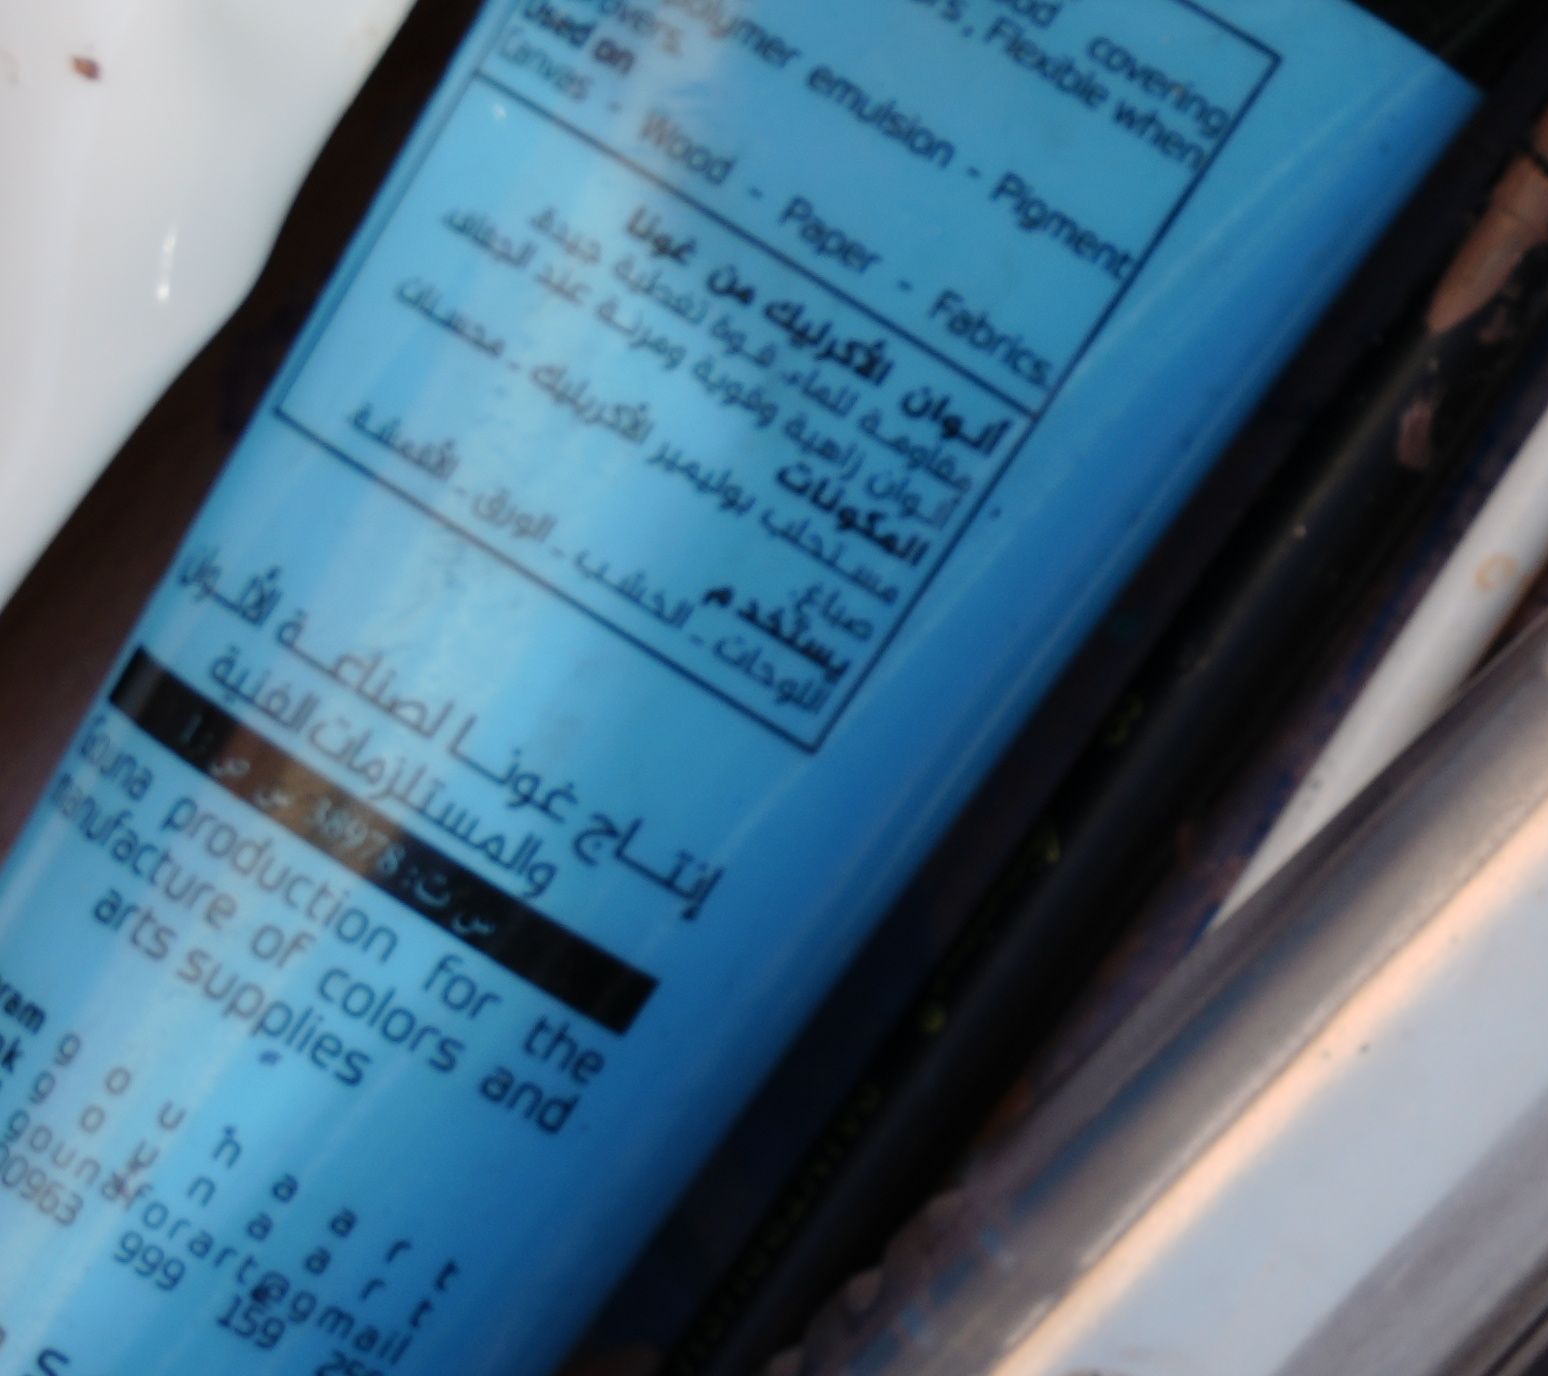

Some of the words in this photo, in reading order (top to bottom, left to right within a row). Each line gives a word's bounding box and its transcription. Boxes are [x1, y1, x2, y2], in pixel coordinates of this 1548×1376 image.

[592, 37, 635, 75] on
[983, 16, 1110, 110] Flexible
[1111, 100, 1209, 177] when
[1086, 36, 1233, 148] covering
[641, 113, 738, 188] Wood
[778, 196, 882, 274] Paper
[804, 65, 956, 169] emulsion
[989, 171, 1137, 290] Pigment
[59, 773, 252, 931] manufacture
[248, 923, 316, 970] of
[316, 967, 466, 1075] colors
[478, 1066, 580, 1135] and
[90, 887, 176, 962] arts
[177, 948, 373, 1089] supplies
[158, 795, 399, 965] production
[422, 954, 502, 1020] for
[522, 1017, 605, 1086] the
[113, 1229, 187, 1293] 999
[216, 1293, 287, 1351] 159
